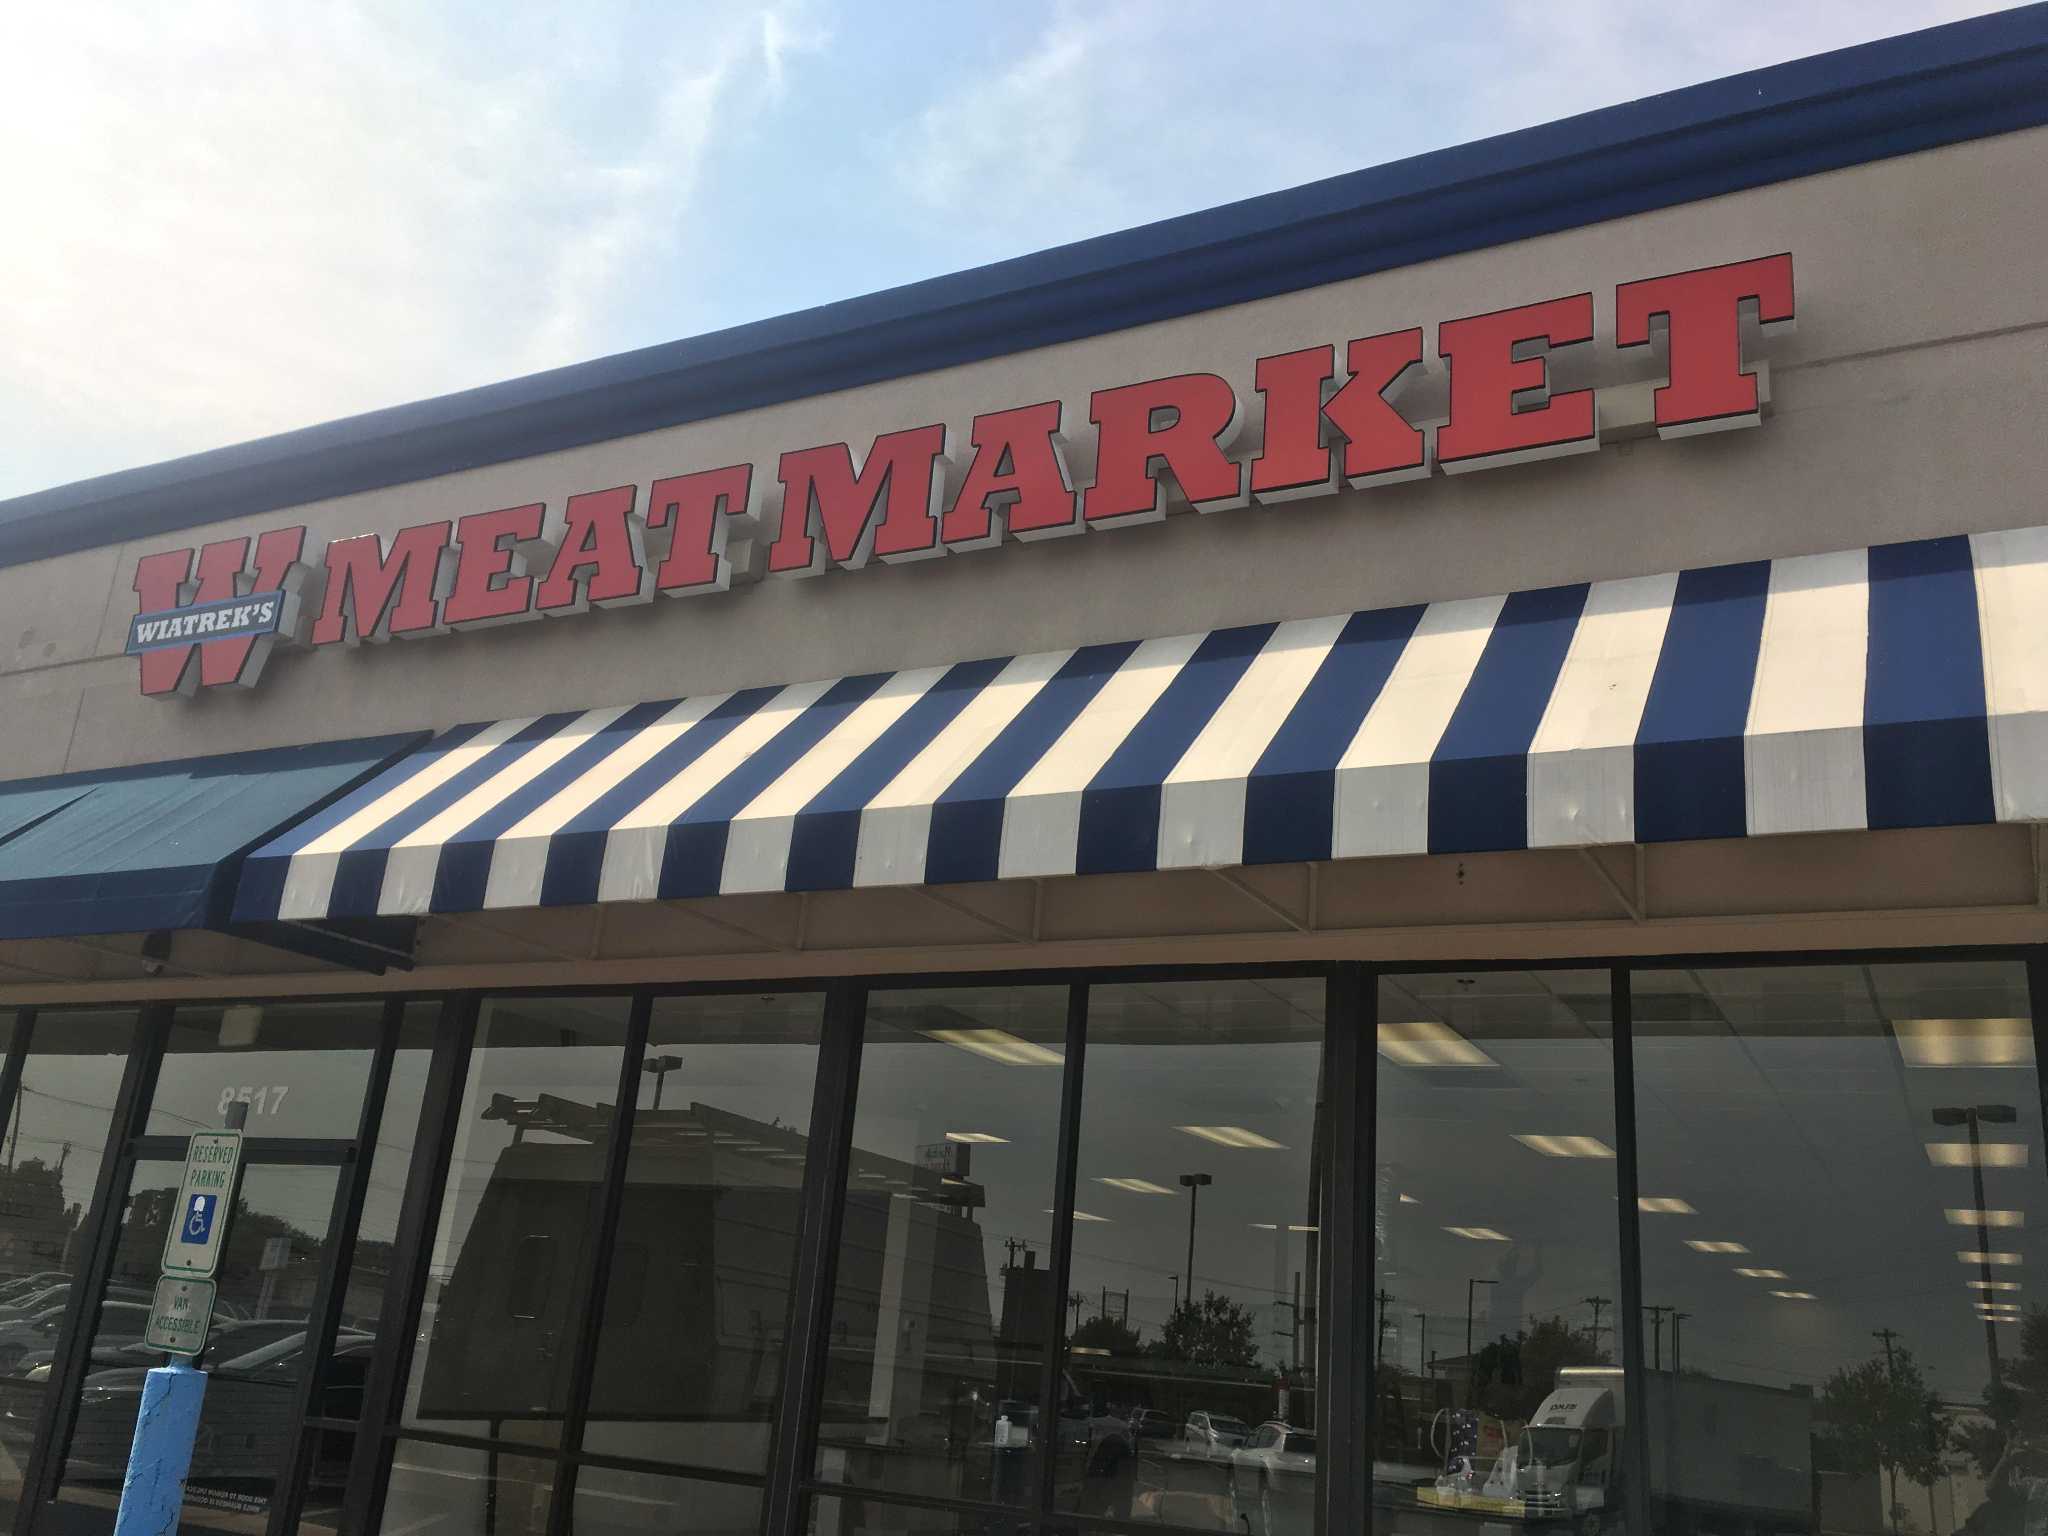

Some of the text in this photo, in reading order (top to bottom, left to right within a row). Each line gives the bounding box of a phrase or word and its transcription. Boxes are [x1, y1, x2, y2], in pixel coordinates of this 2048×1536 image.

[312, 252, 1796, 645] MEAT MARKET
[136, 601, 275, 644] WIATREK'S
[192, 1145, 234, 1165] RESERVED
[190, 1169, 226, 1189] PARKING
